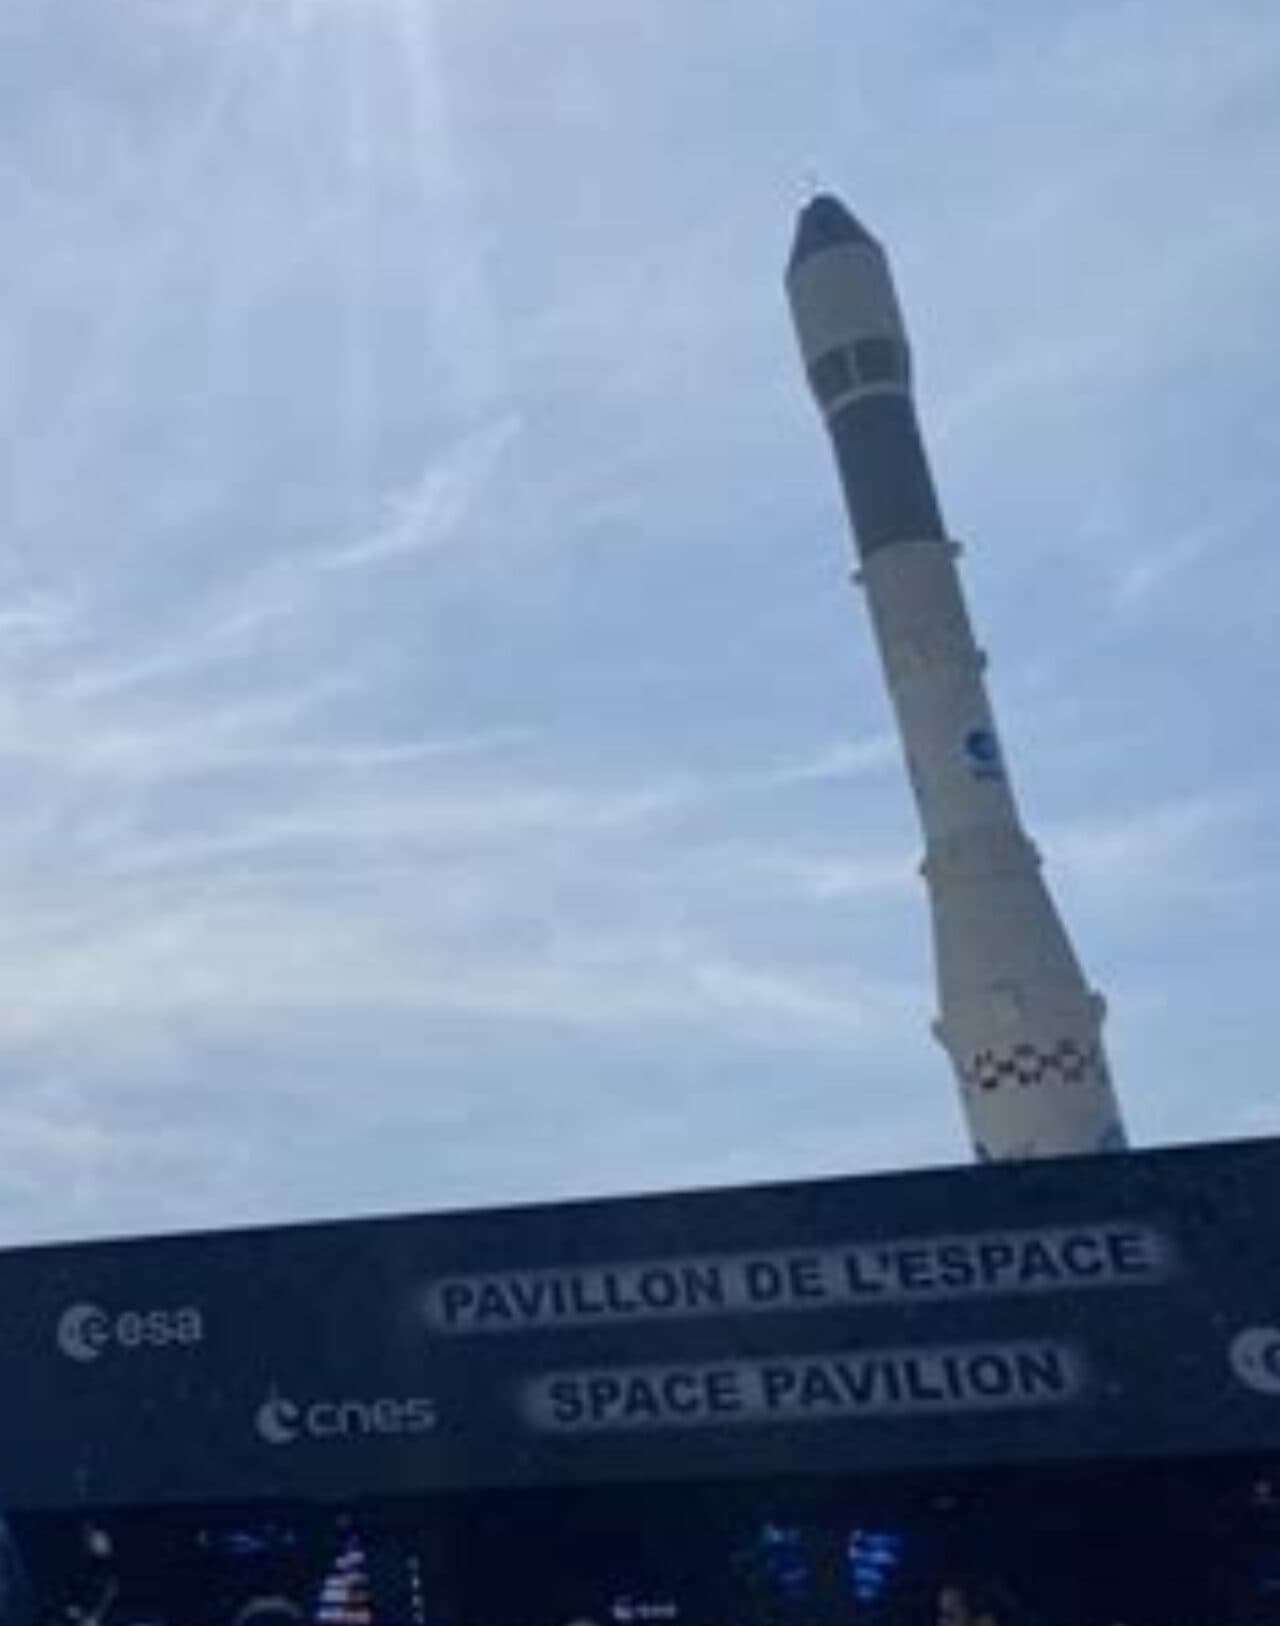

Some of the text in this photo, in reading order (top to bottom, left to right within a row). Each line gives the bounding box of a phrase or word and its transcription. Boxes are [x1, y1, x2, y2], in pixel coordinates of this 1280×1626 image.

[440, 1233, 1151, 1322] PAVILLON DE L'ESPACE
[117, 1306, 204, 1347] esa
[549, 1349, 1064, 1423] SPACE PAVILION
[306, 1397, 438, 1436] cnes
